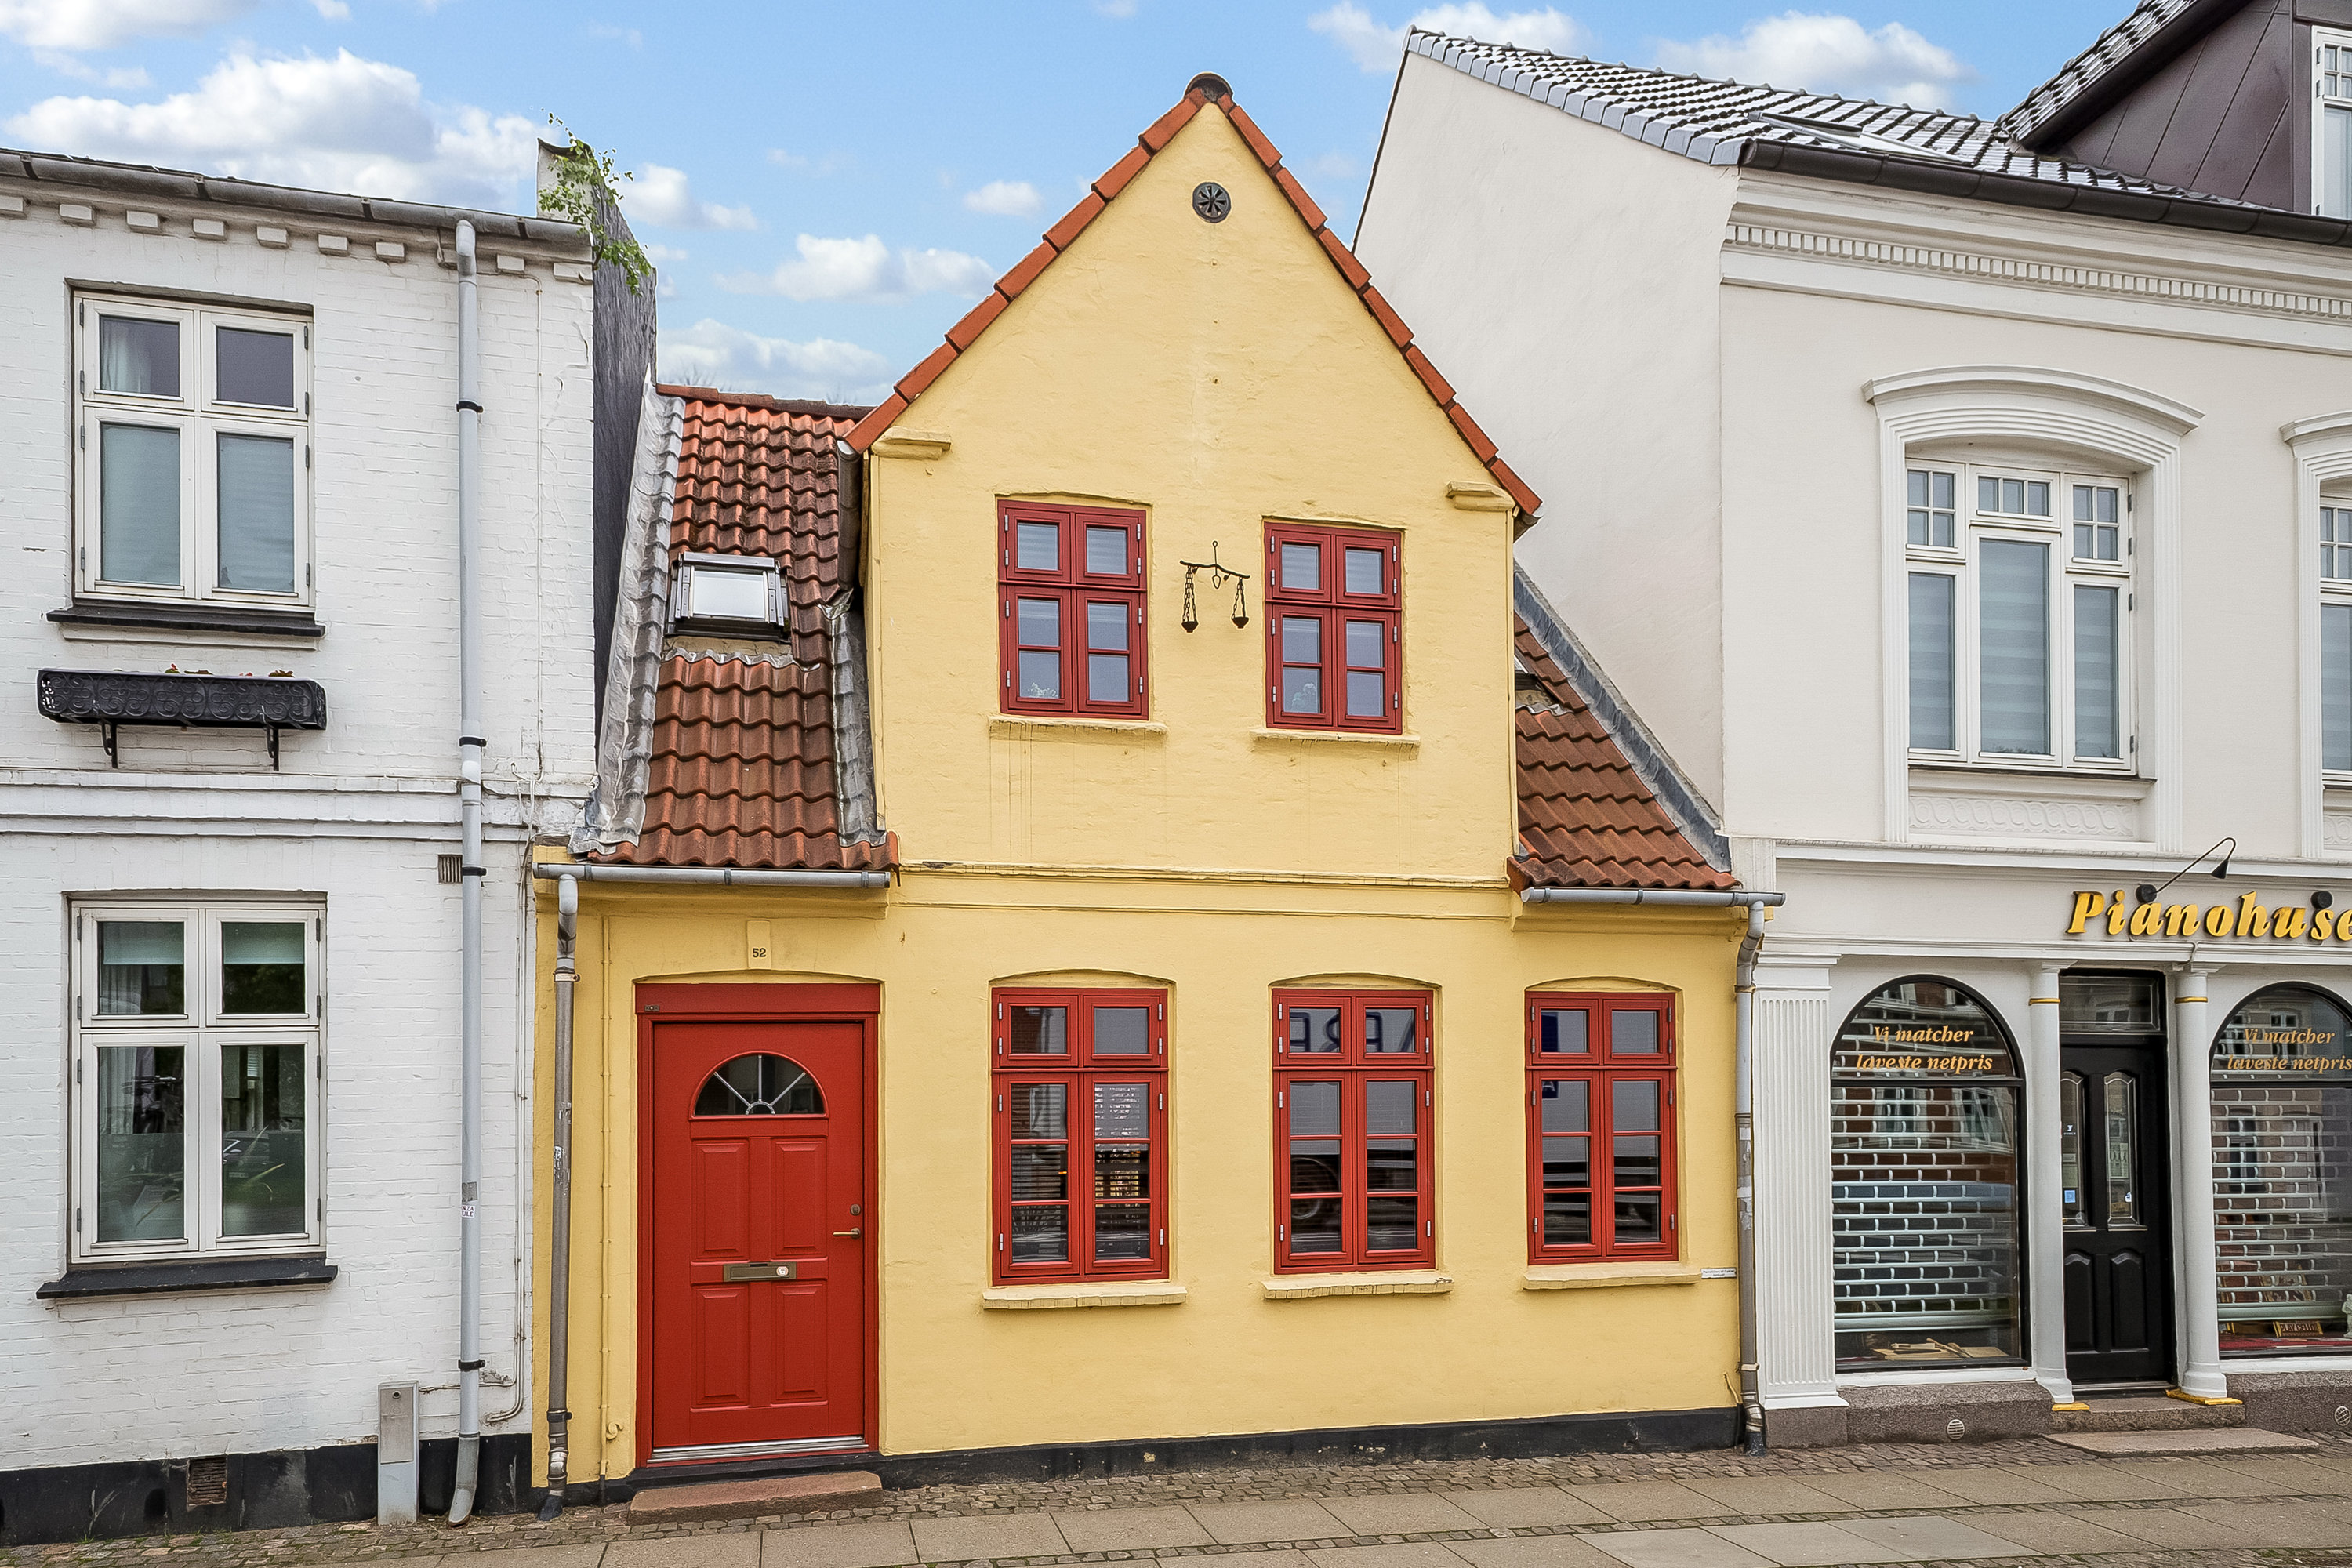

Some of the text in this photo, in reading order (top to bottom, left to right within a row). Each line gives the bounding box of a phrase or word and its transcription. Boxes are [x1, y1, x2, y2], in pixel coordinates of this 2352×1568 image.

[2066, 889, 2352, 940] Pianohuse
[752, 947, 766, 957] 52
[1875, 1025, 1973, 1042] Vi matcher
[2245, 1028, 2335, 1044] Vi matcher
[1856, 1054, 1993, 1074] laveste netpris
[2227, 1054, 2352, 1074] laveste netpris
